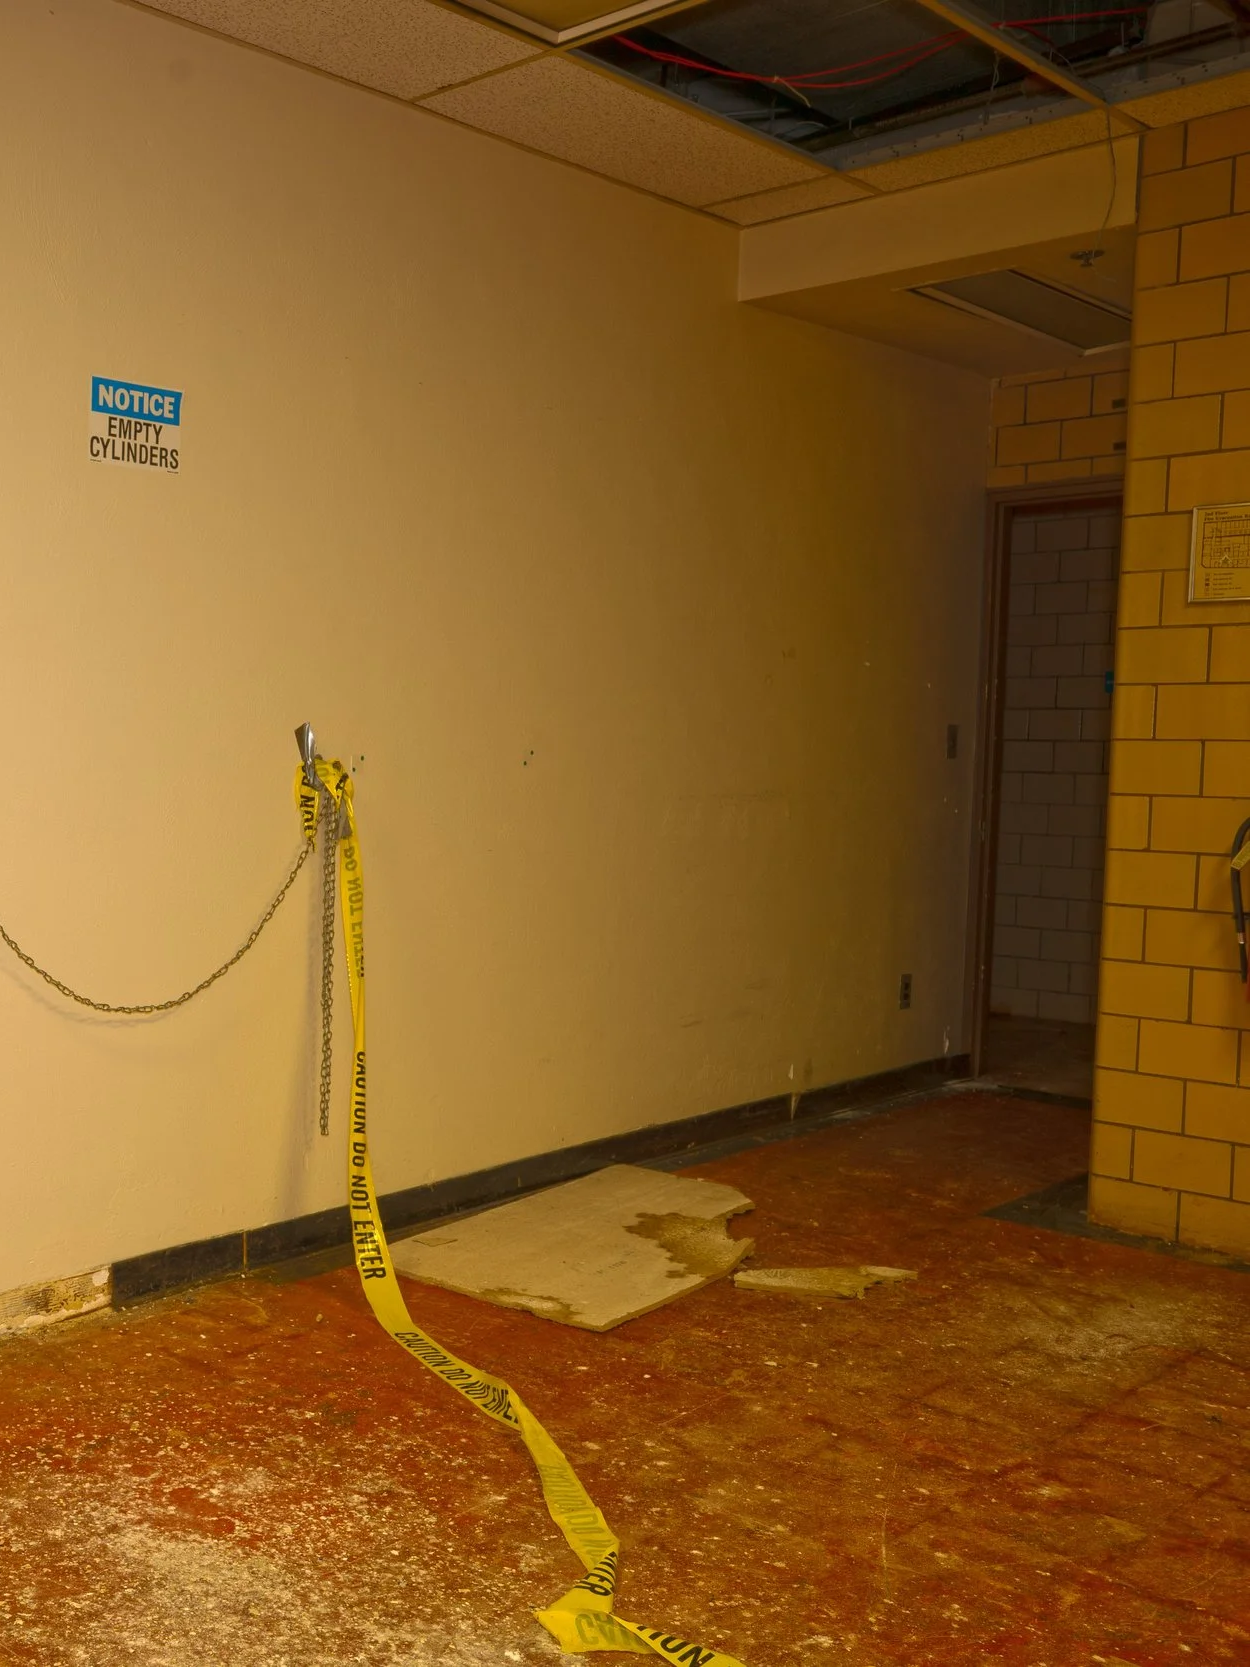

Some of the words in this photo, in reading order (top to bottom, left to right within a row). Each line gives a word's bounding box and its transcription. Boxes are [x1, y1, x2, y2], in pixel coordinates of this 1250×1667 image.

[98, 384, 175, 419] NOTICE
[108, 416, 163, 445] EMPTY
[90, 435, 179, 470] CYLINDERS
[352, 1141, 367, 1168] DO
[351, 1175, 372, 1214] NOT
[353, 1222, 387, 1280] ENTER
[394, 1332, 456, 1367] CAUTION
[438, 1368, 472, 1380] DO
